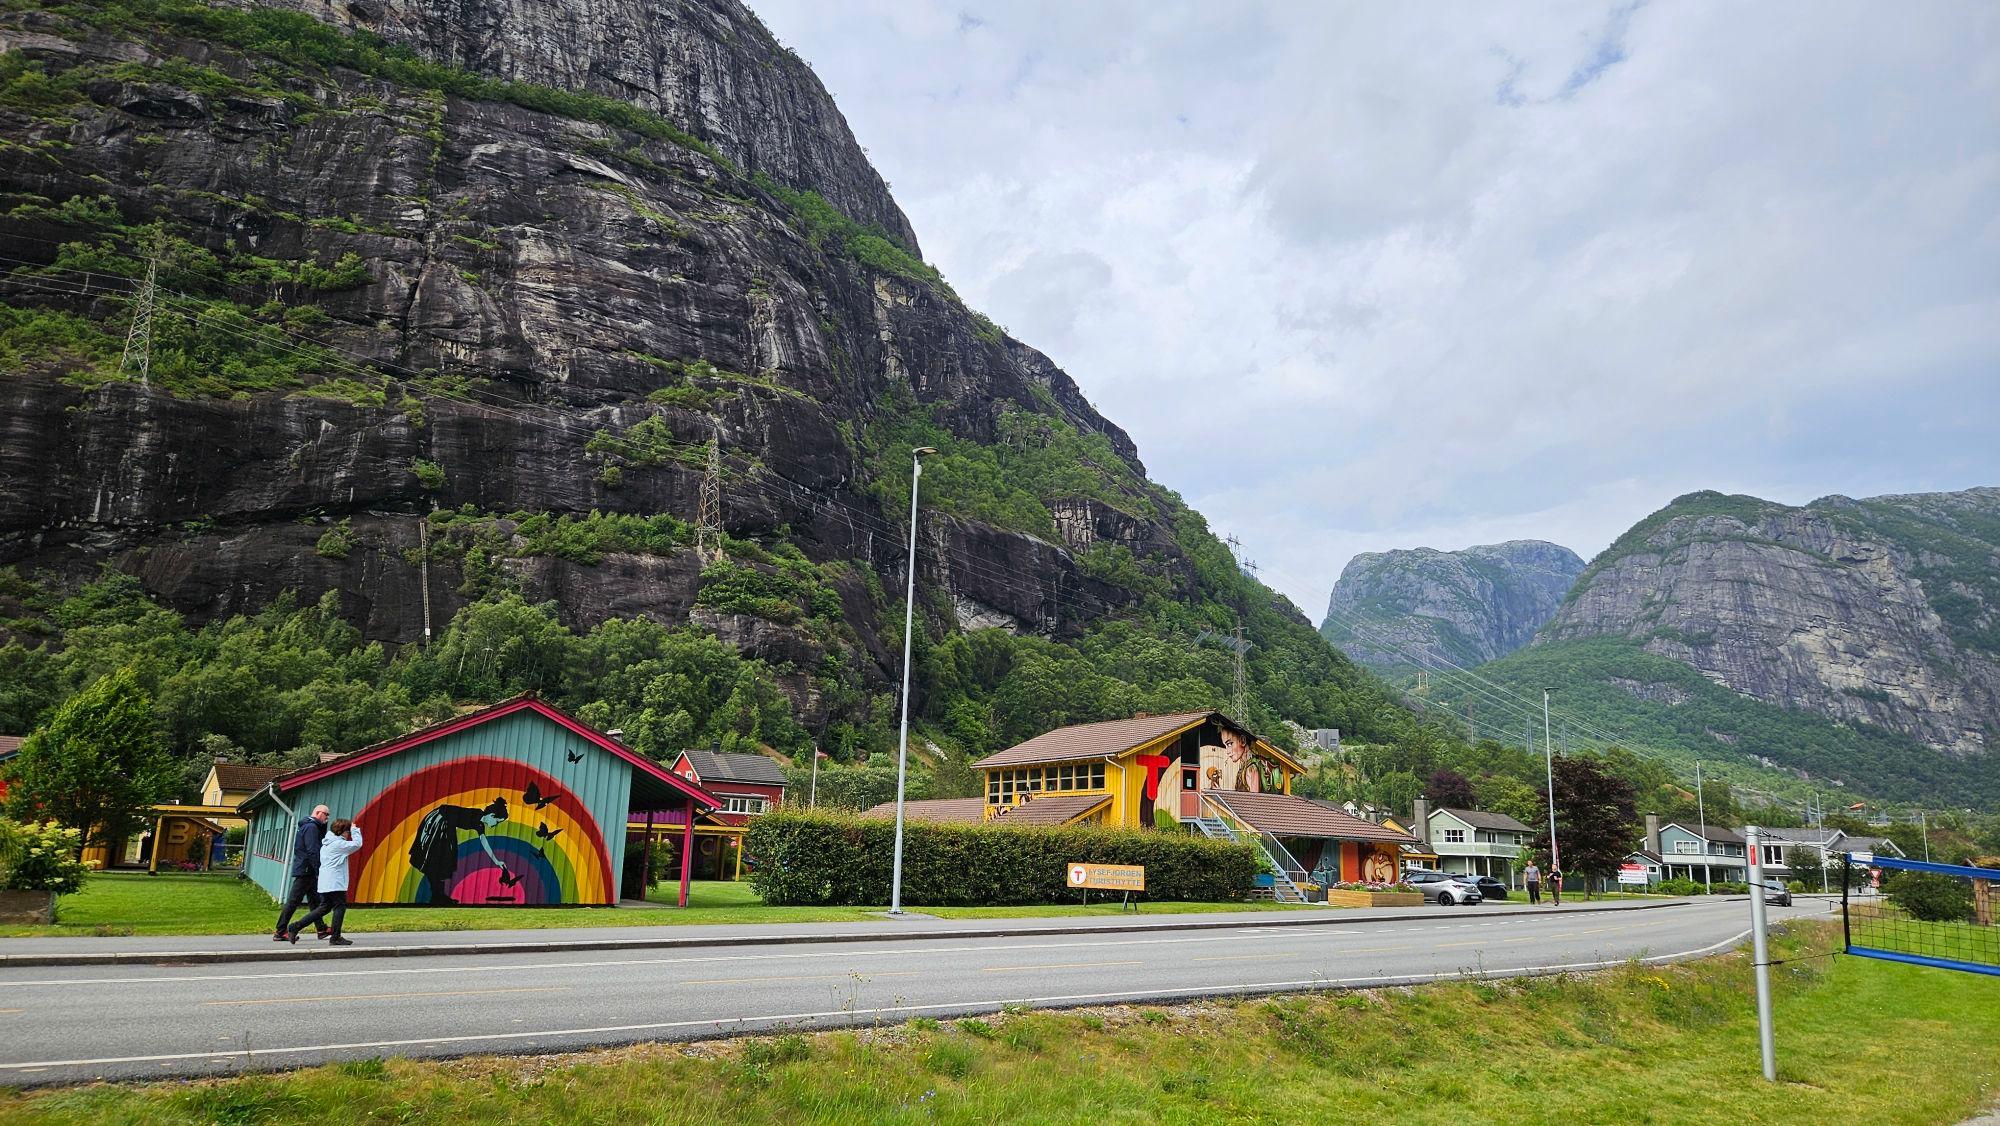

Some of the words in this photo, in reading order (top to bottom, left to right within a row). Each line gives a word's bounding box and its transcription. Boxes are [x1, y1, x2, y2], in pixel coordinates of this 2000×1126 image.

[1135, 755, 1170, 801] T
[168, 821, 190, 844] B
[1074, 871, 1083, 882] T
[1089, 877, 1141, 886] TURISTHYTTE
